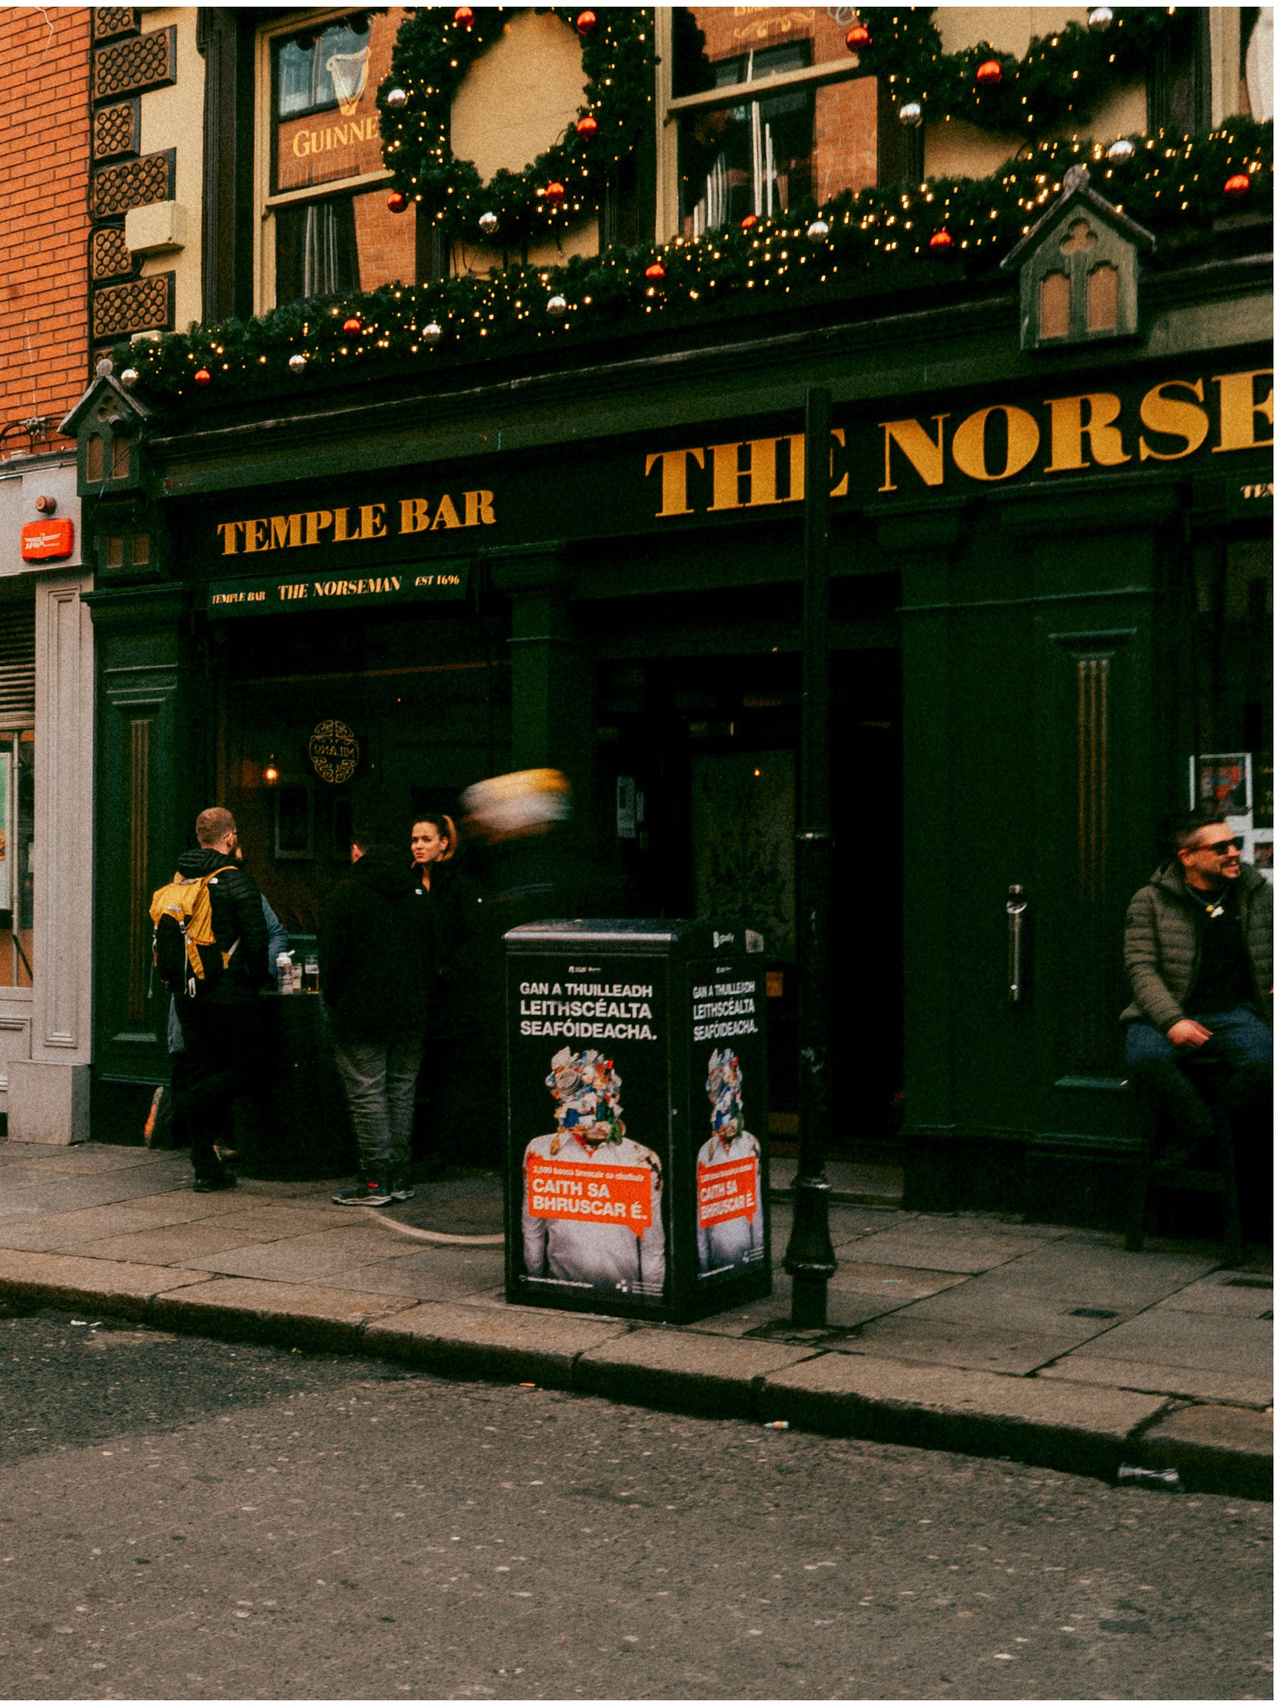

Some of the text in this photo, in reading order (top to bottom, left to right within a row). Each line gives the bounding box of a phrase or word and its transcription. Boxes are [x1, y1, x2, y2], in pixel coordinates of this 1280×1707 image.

[292, 116, 379, 157] GUINNE
[645, 369, 1274, 518] THE NORSE
[217, 489, 497, 556] TEMPLE BAR
[212, 574, 460, 605] TEMPLE BAR THE NORSEMAN EST 1696
[520, 982, 653, 998] GAN A THUILLEADH
[693, 986, 707, 999] GAN
[708, 985, 714, 997] A
[520, 998, 652, 1019] LEITHSCÉALTA
[693, 997, 756, 1020] LEITHSCÉALTA
[520, 1018, 657, 1040] SEAFÓIDEACHA.
[693, 1019, 759, 1041] SEAFÓIDEACHA.
[532, 1178, 611, 1199] CAITH SA
[532, 1195, 648, 1220] BHRUSCAR É.
